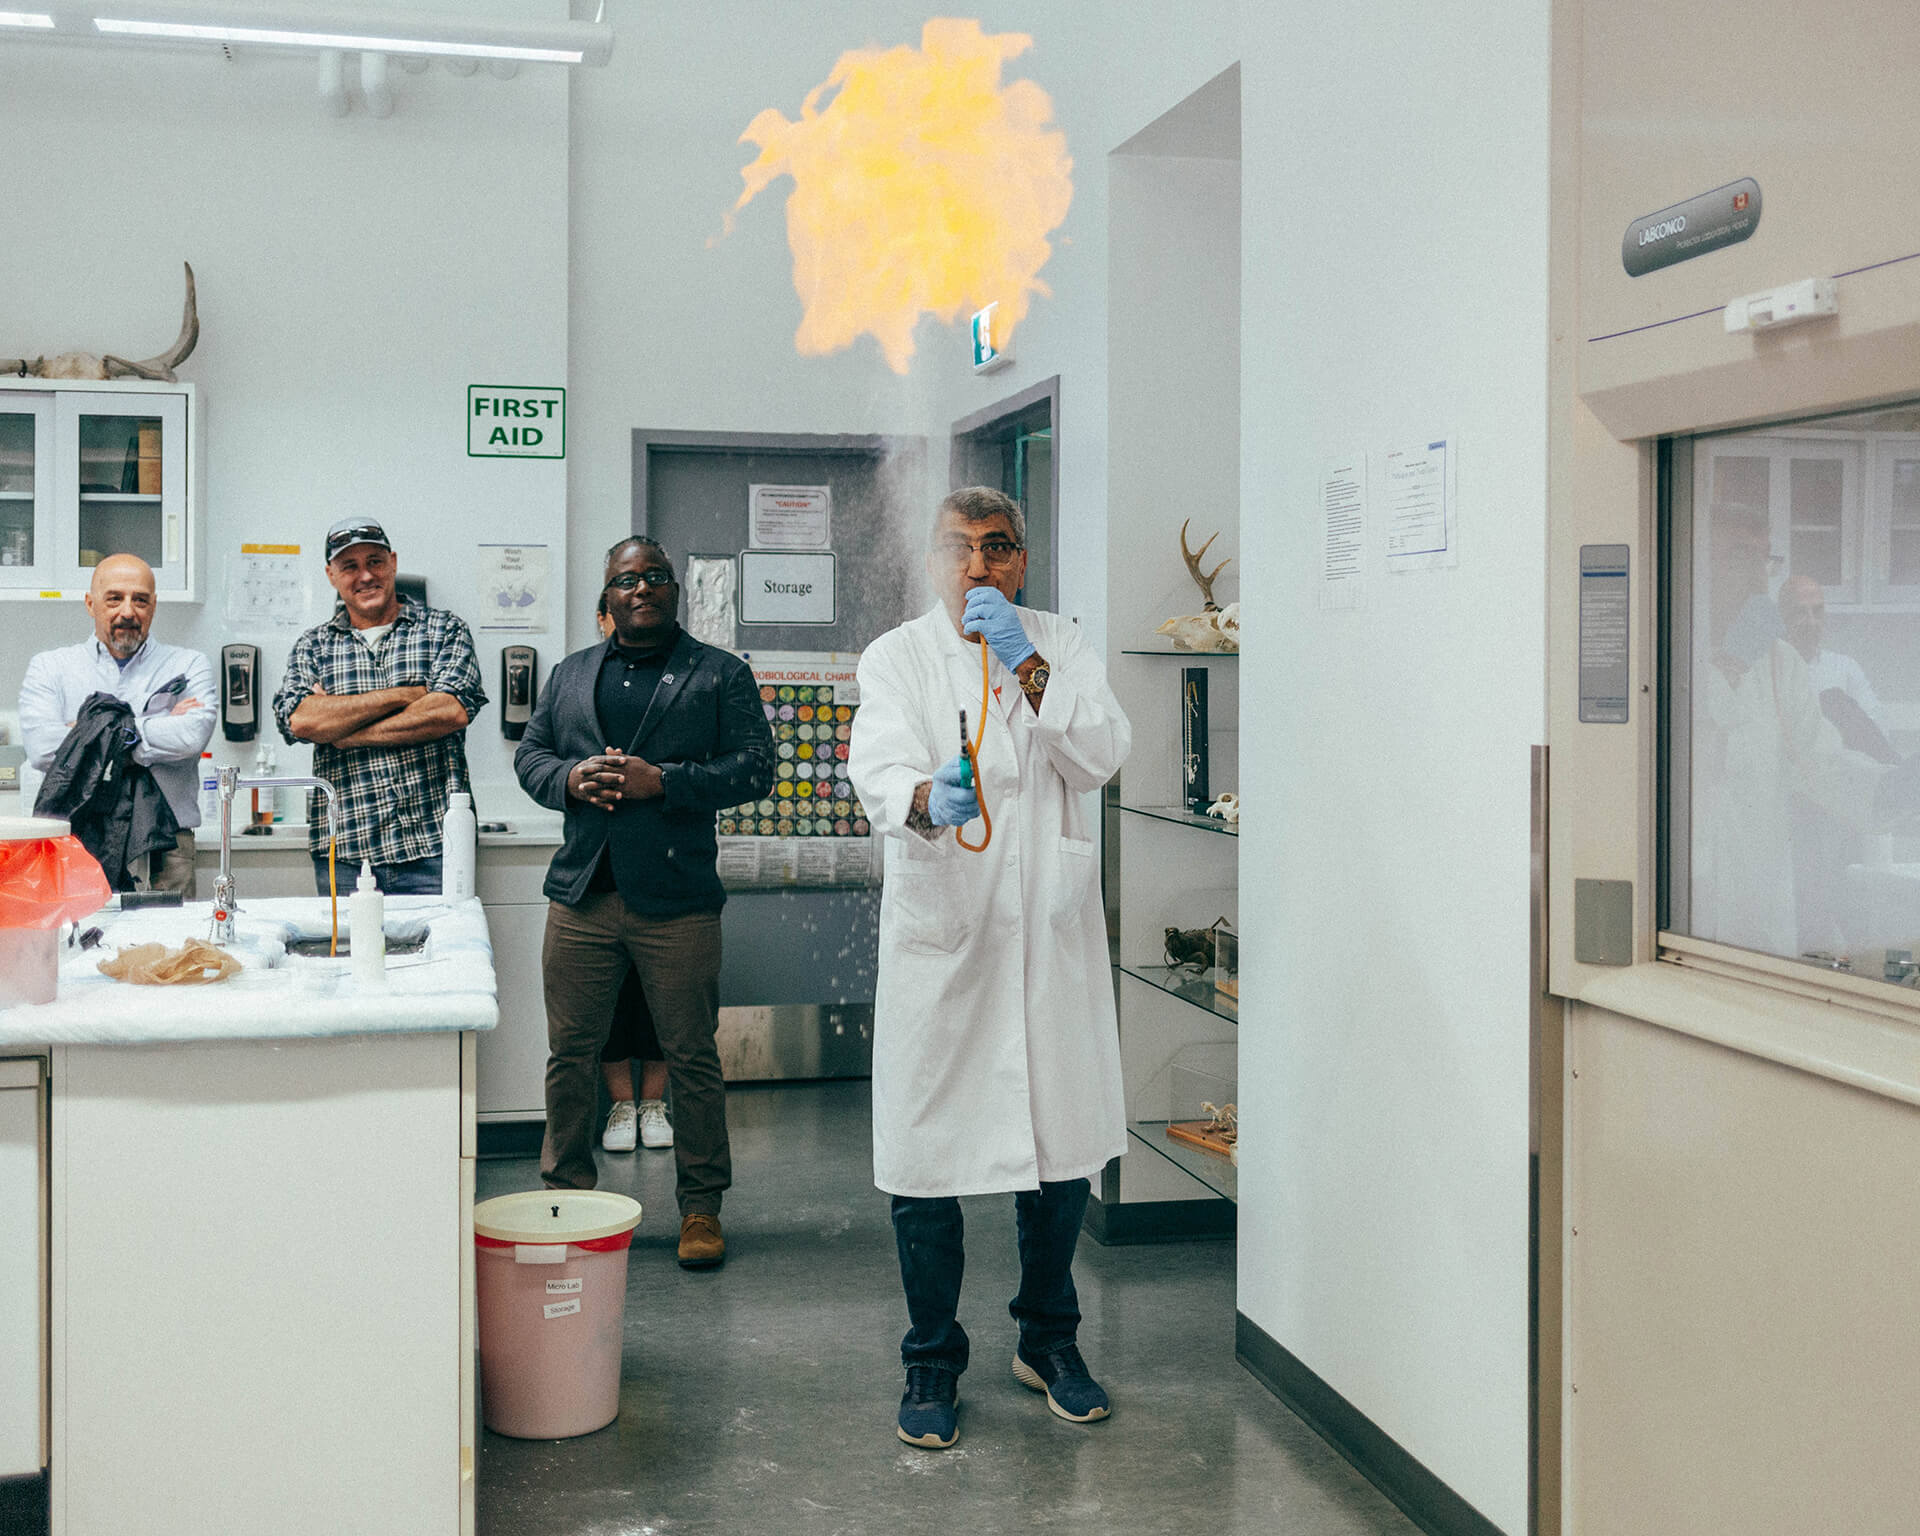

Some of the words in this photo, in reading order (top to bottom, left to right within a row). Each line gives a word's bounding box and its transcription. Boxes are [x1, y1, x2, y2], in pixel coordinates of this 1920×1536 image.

[1639, 216, 1686, 246] LABCONCO
[475, 397, 559, 418] FIRST
[488, 426, 544, 446] AID
[764, 580, 812, 597] Storage
[825, 672, 857, 681] CHART
